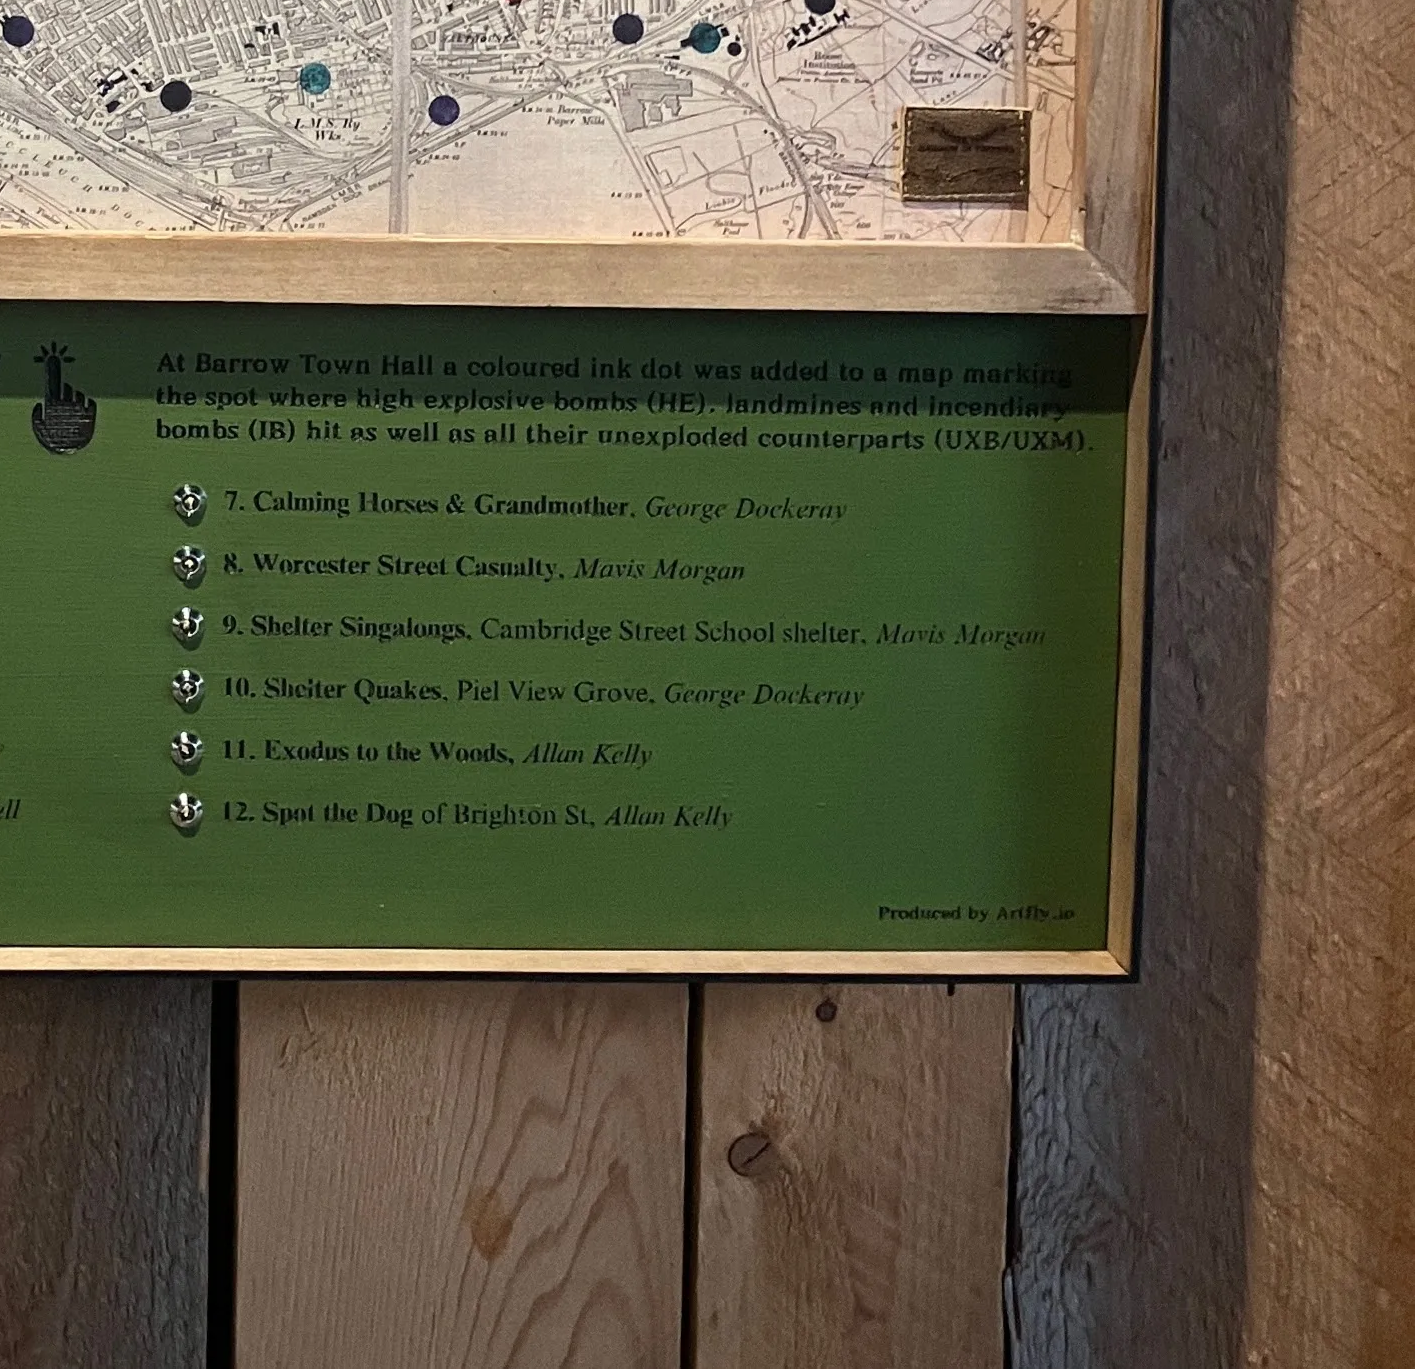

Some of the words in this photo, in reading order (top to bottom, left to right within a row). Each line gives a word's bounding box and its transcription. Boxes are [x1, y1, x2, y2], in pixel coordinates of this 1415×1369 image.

[155, 418, 239, 441] bombs
[248, 417, 296, 443] (IB)
[306, 419, 342, 441] hit
[350, 425, 377, 442] as
[387, 421, 439, 443] well
[448, 427, 475, 445] as
[484, 422, 516, 445] all
[526, 422, 588, 446] their
[598, 423, 748, 452] unexploded
[758, 429, 925, 454] counterparts
[224, 490, 245, 511] 7.
[252, 490, 351, 520] Calming
[357, 491, 439, 515] Horses
[445, 493, 465, 515] &
[645, 495, 727, 524] George
[734, 496, 847, 526] Dockeray
[223, 551, 244, 575] 8.
[252, 553, 371, 575] Worcester
[377, 553, 446, 577] Street
[573, 557, 645, 579] Mavis
[652, 558, 745, 586] Morgan
